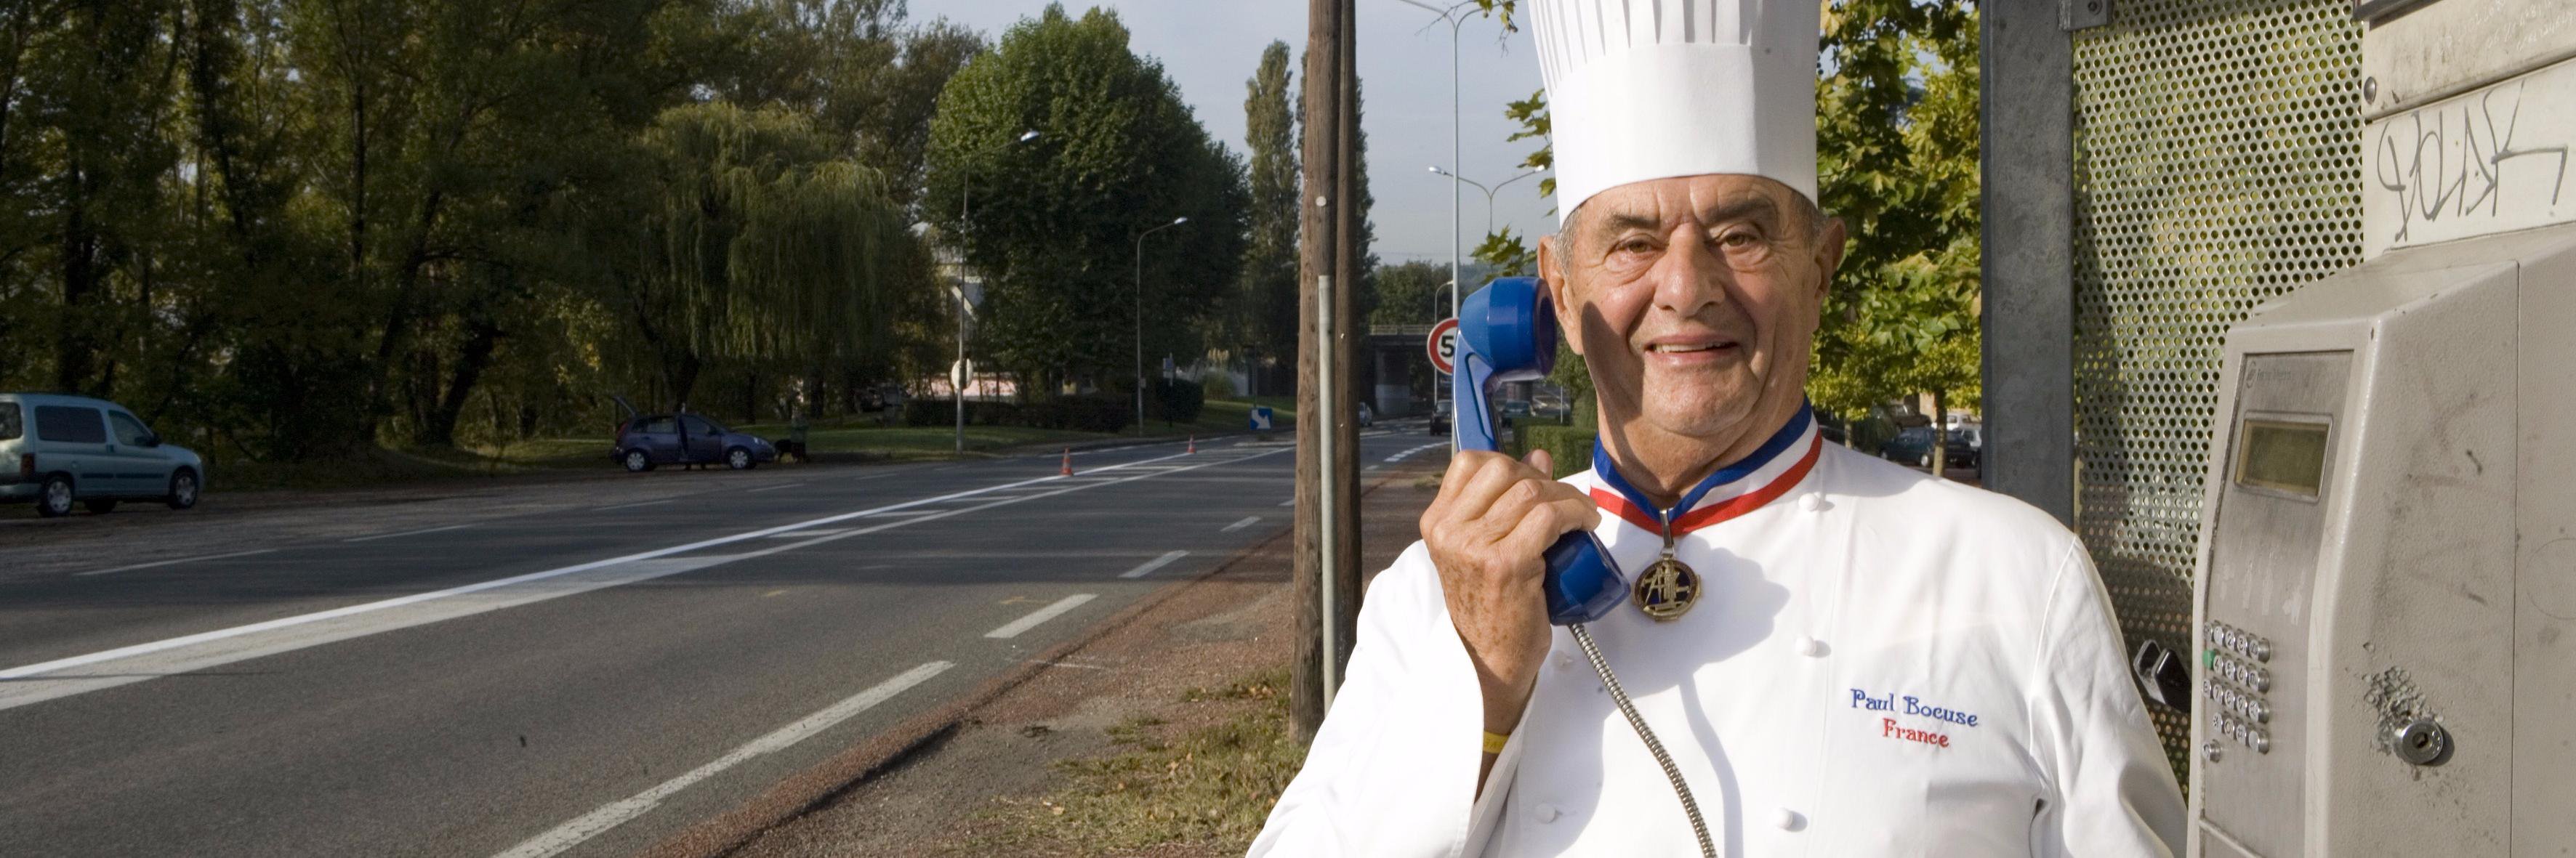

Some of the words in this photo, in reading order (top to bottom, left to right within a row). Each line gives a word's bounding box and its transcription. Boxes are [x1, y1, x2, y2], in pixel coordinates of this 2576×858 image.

[1441, 335, 1456, 357] 5
[1851, 688, 1895, 711] Paul
[1903, 695, 1978, 727] Bocuse
[1883, 717, 1949, 748] France
